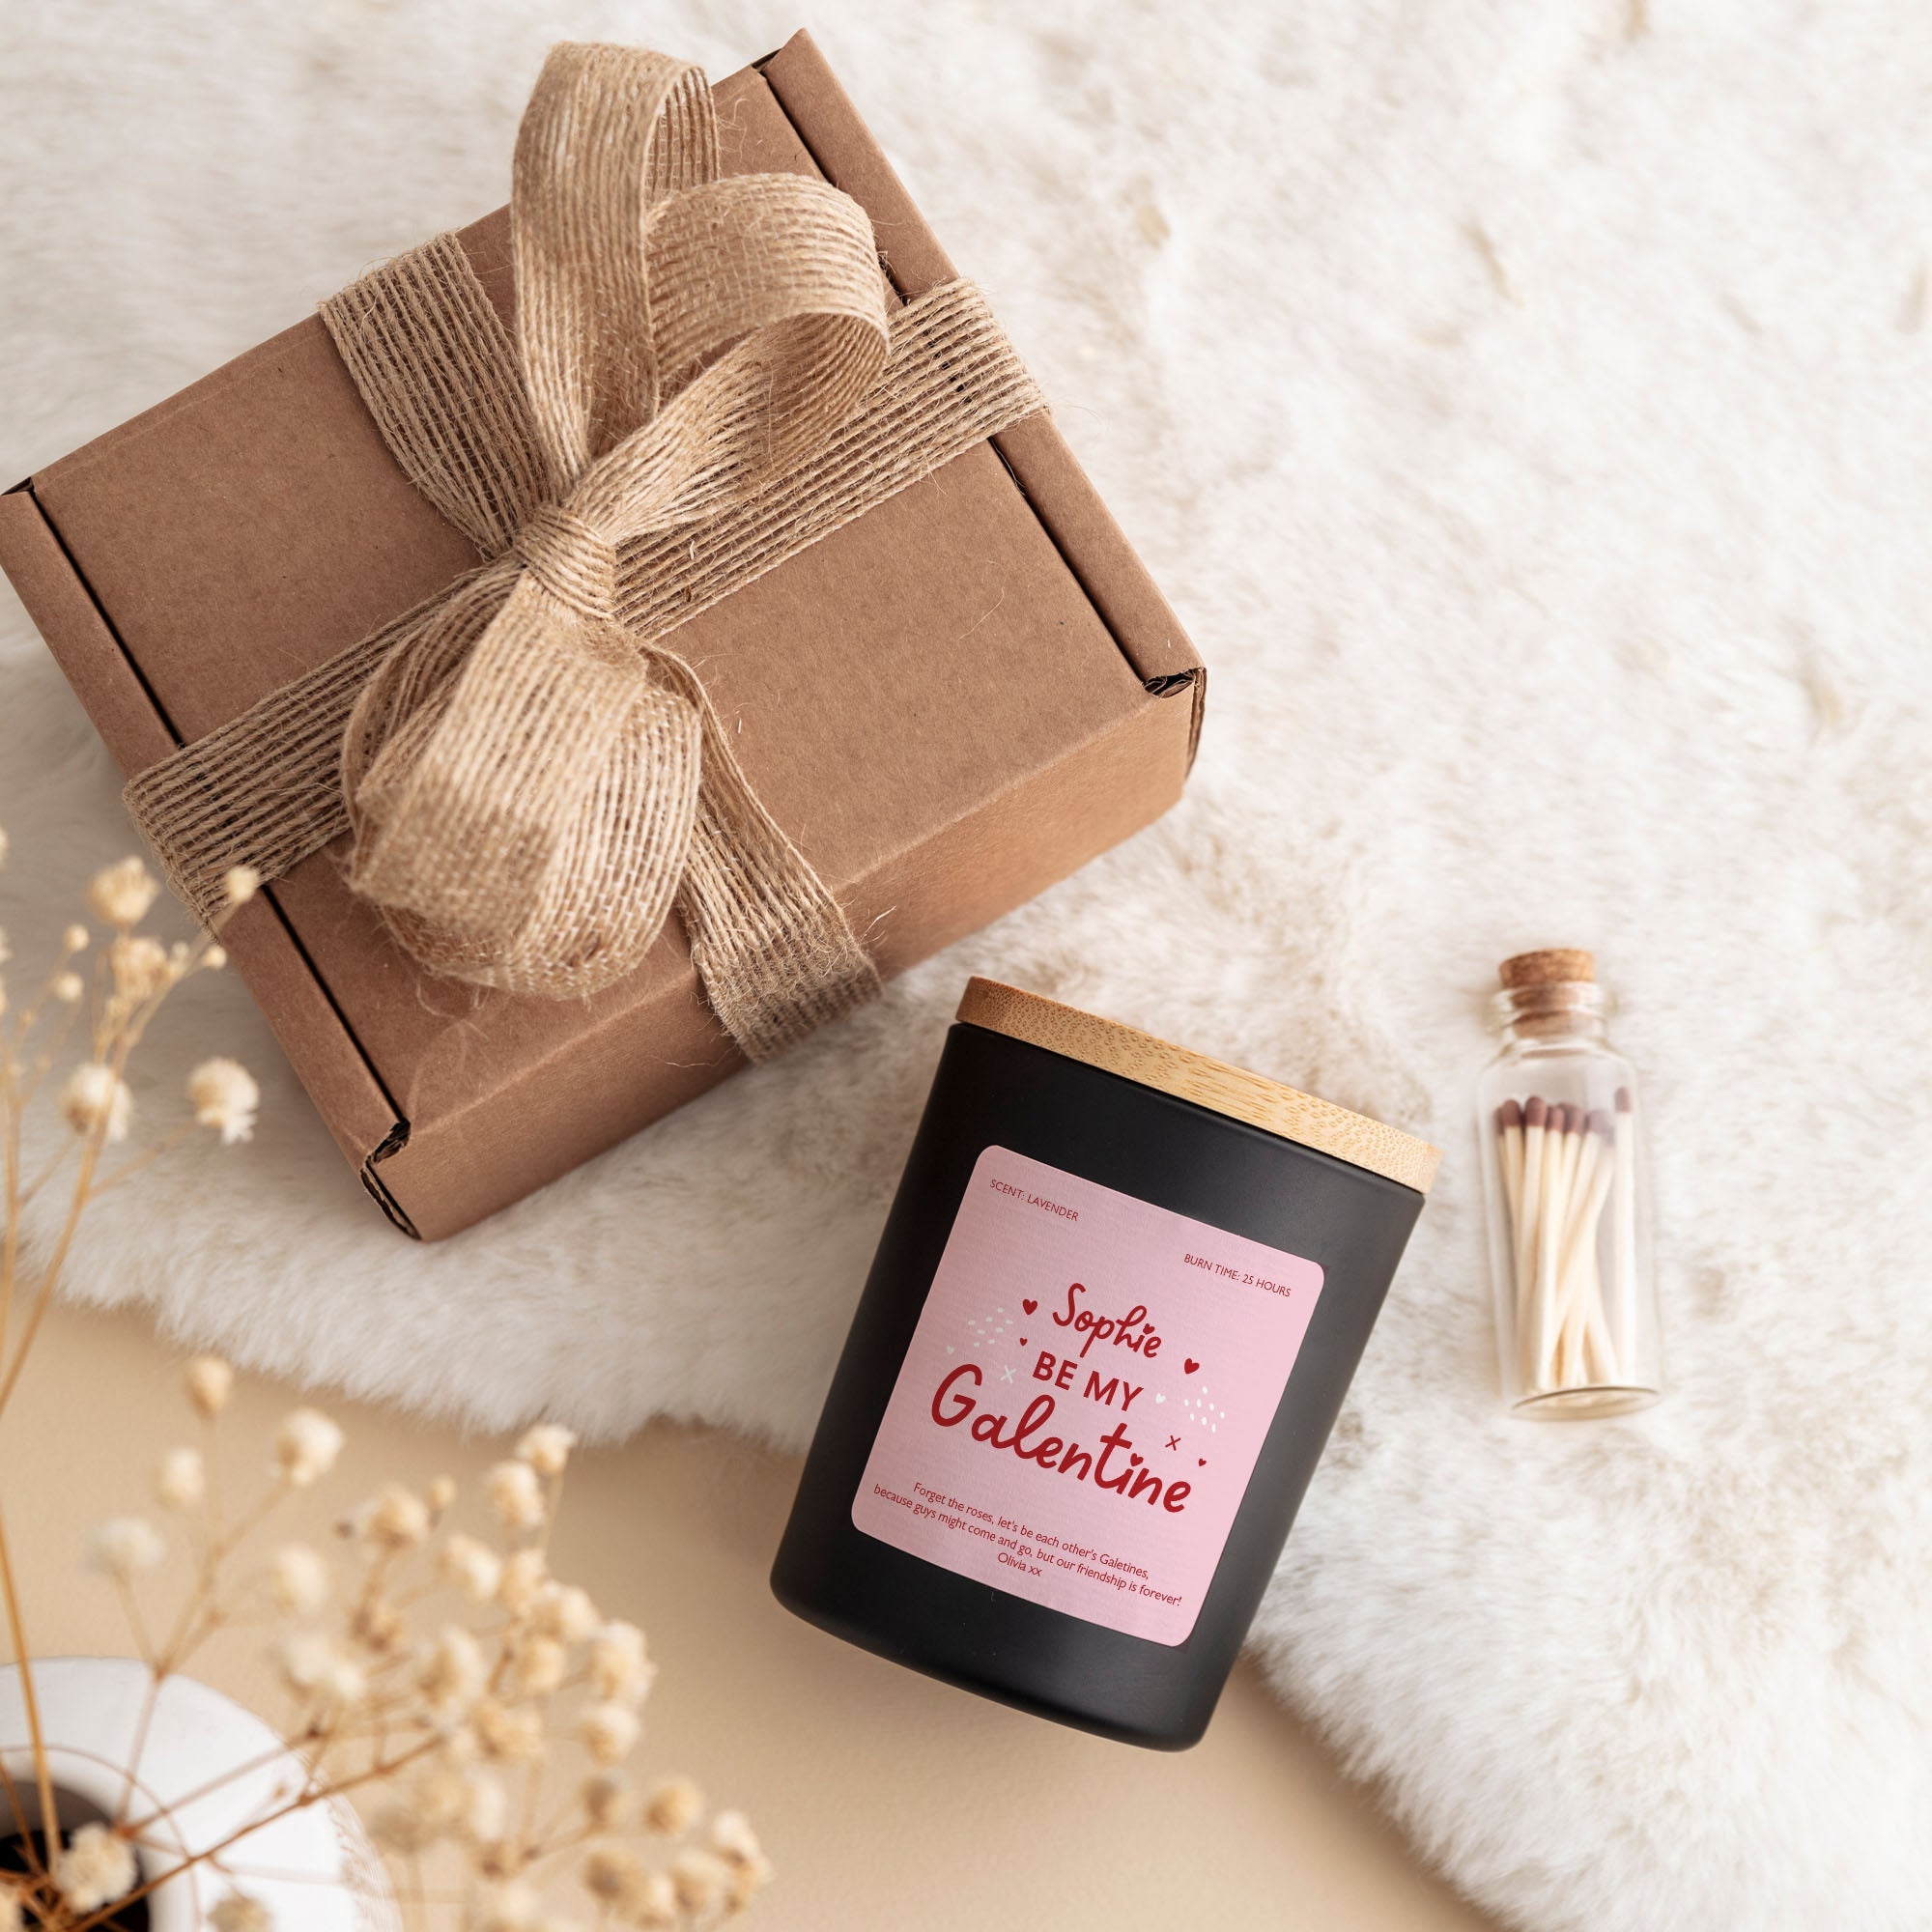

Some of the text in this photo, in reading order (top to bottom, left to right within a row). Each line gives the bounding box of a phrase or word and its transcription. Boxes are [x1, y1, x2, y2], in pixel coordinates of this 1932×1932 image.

[990, 1179, 1079, 1221] SCENT: LAVENDER
[1183, 1253, 1292, 1297] BURN TIME: 25 HOURS
[1052, 1283, 1162, 1358] Sophie
[1032, 1350, 1144, 1411] BE MY
[931, 1363, 1191, 1513] Galentine
[873, 1483, 1182, 1606] because guys might come and go, but our friendship is forever!
[913, 1482, 1149, 1579] Forget the roses, let's be each other's Galetines,
[997, 1552, 1042, 1577] Olivia xx
